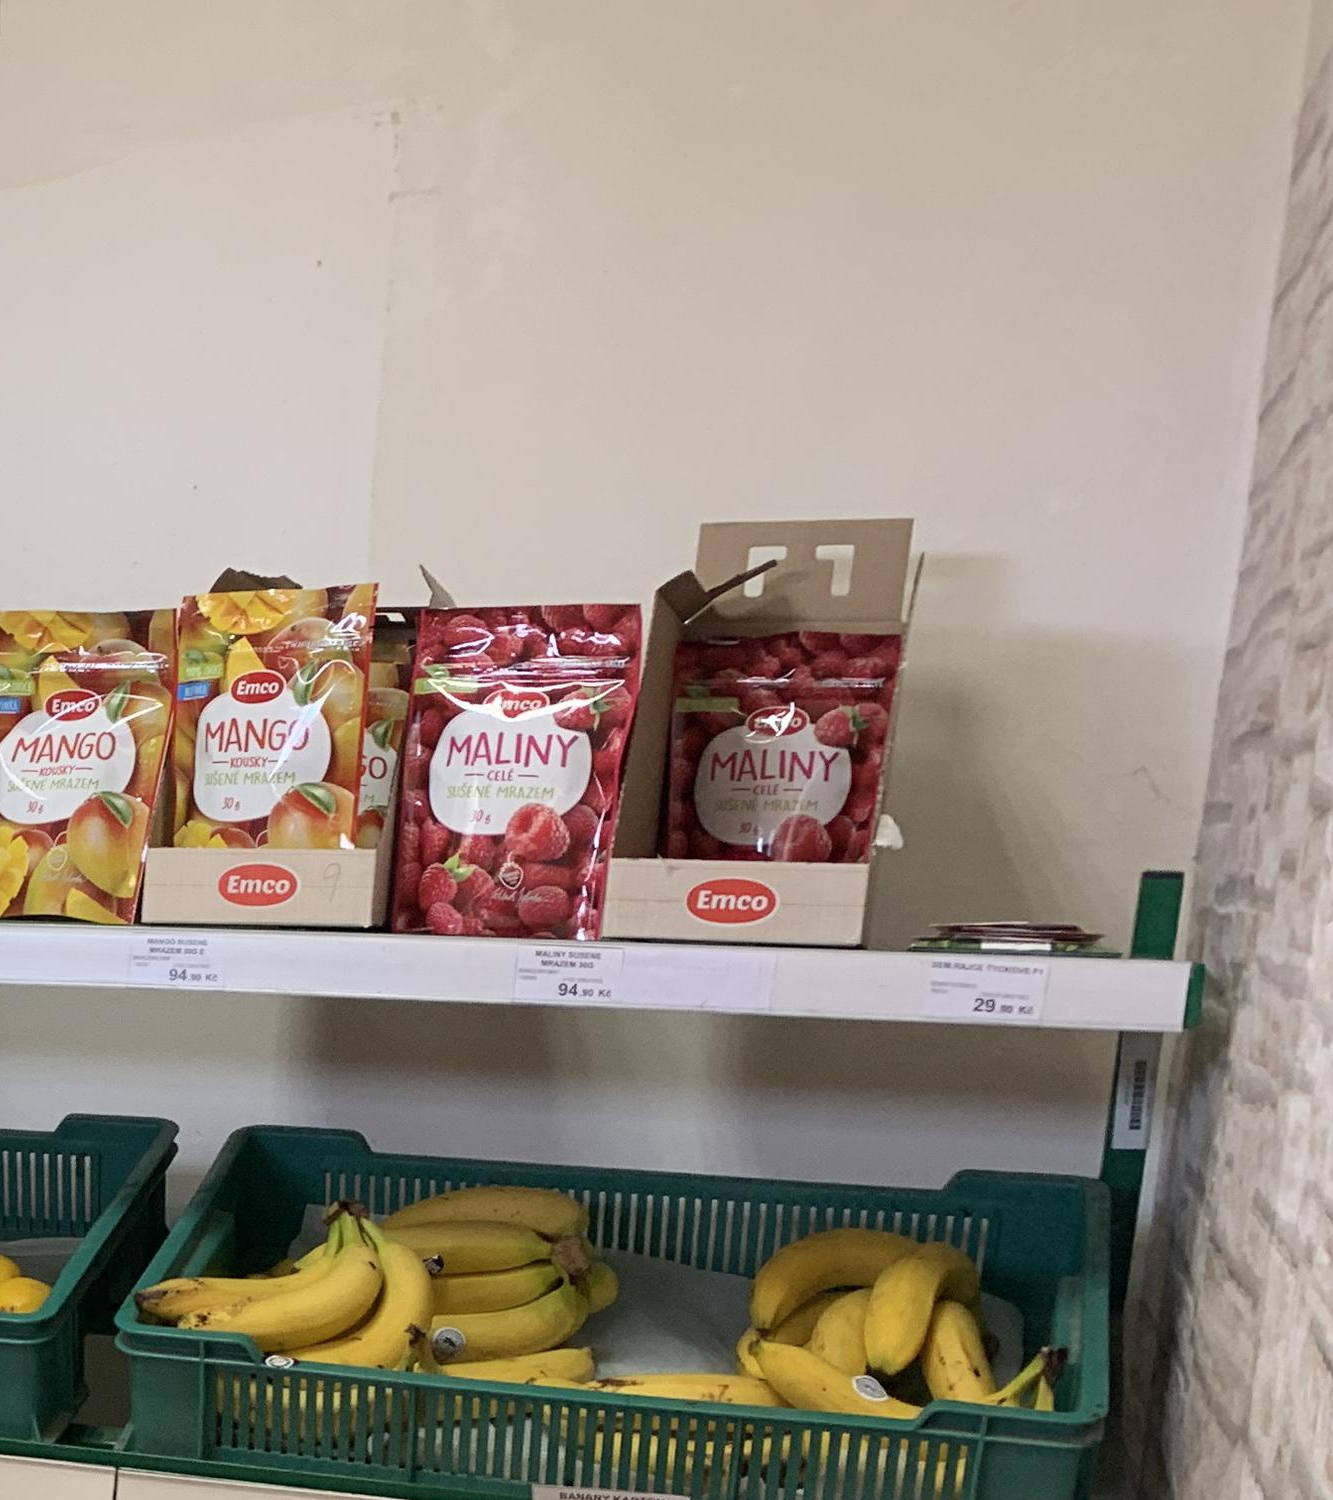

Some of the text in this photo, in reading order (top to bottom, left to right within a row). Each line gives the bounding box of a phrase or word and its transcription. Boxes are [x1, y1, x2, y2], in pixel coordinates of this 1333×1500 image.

[236, 680, 280, 696] Emco
[50, 699, 97, 714] Emco
[204, 717, 311, 754] MANGO
[10, 731, 117, 765] MANGO
[445, 730, 581, 769] MALINY
[229, 756, 269, 769] KOUSKY
[709, 748, 841, 783] MALINY
[37, 765, 76, 778] KOUSKY
[485, 767, 516, 783] CELÉ
[48, 777, 101, 791] MRAZEM
[495, 785, 555, 800] MRAZEM
[225, 874, 292, 896] Emco
[695, 888, 770, 913] Emco
[534, 950, 566, 960] MALINY
[540, 959, 577, 969] MRAZEM
